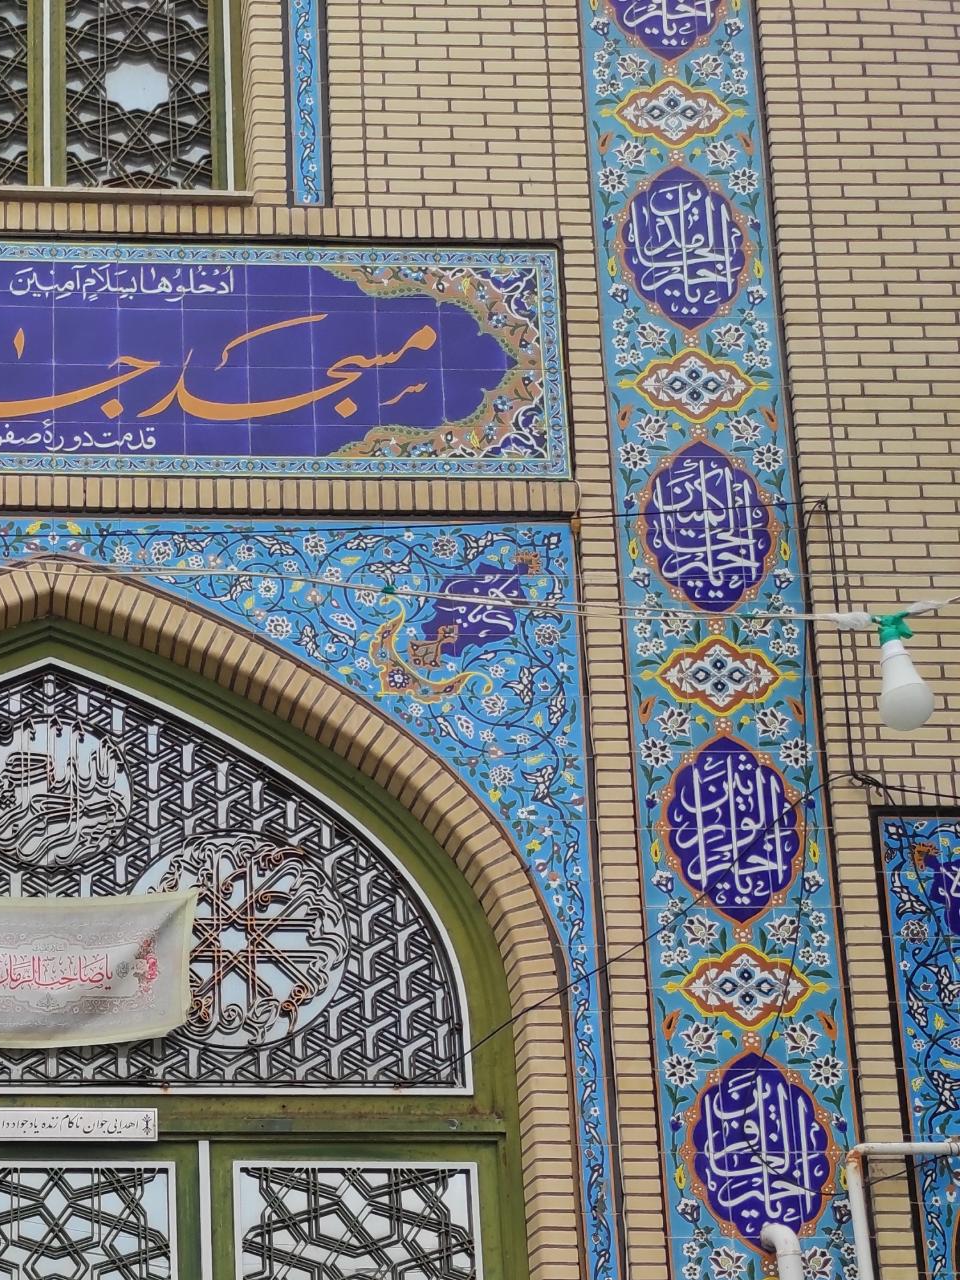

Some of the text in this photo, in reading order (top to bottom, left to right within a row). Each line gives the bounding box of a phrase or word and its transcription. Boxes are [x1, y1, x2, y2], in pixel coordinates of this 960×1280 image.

[137, 314, 437, 421] مسجد
[93, 426, 157, 451] قدمت
[11, 1118, 28, 1133] جواد
[28, 1118, 39, 1133] یاد
[41, 1116, 59, 1130] زنده
[60, 1113, 83, 1132] ناکام
[82, 1118, 108, 1134] جوان
